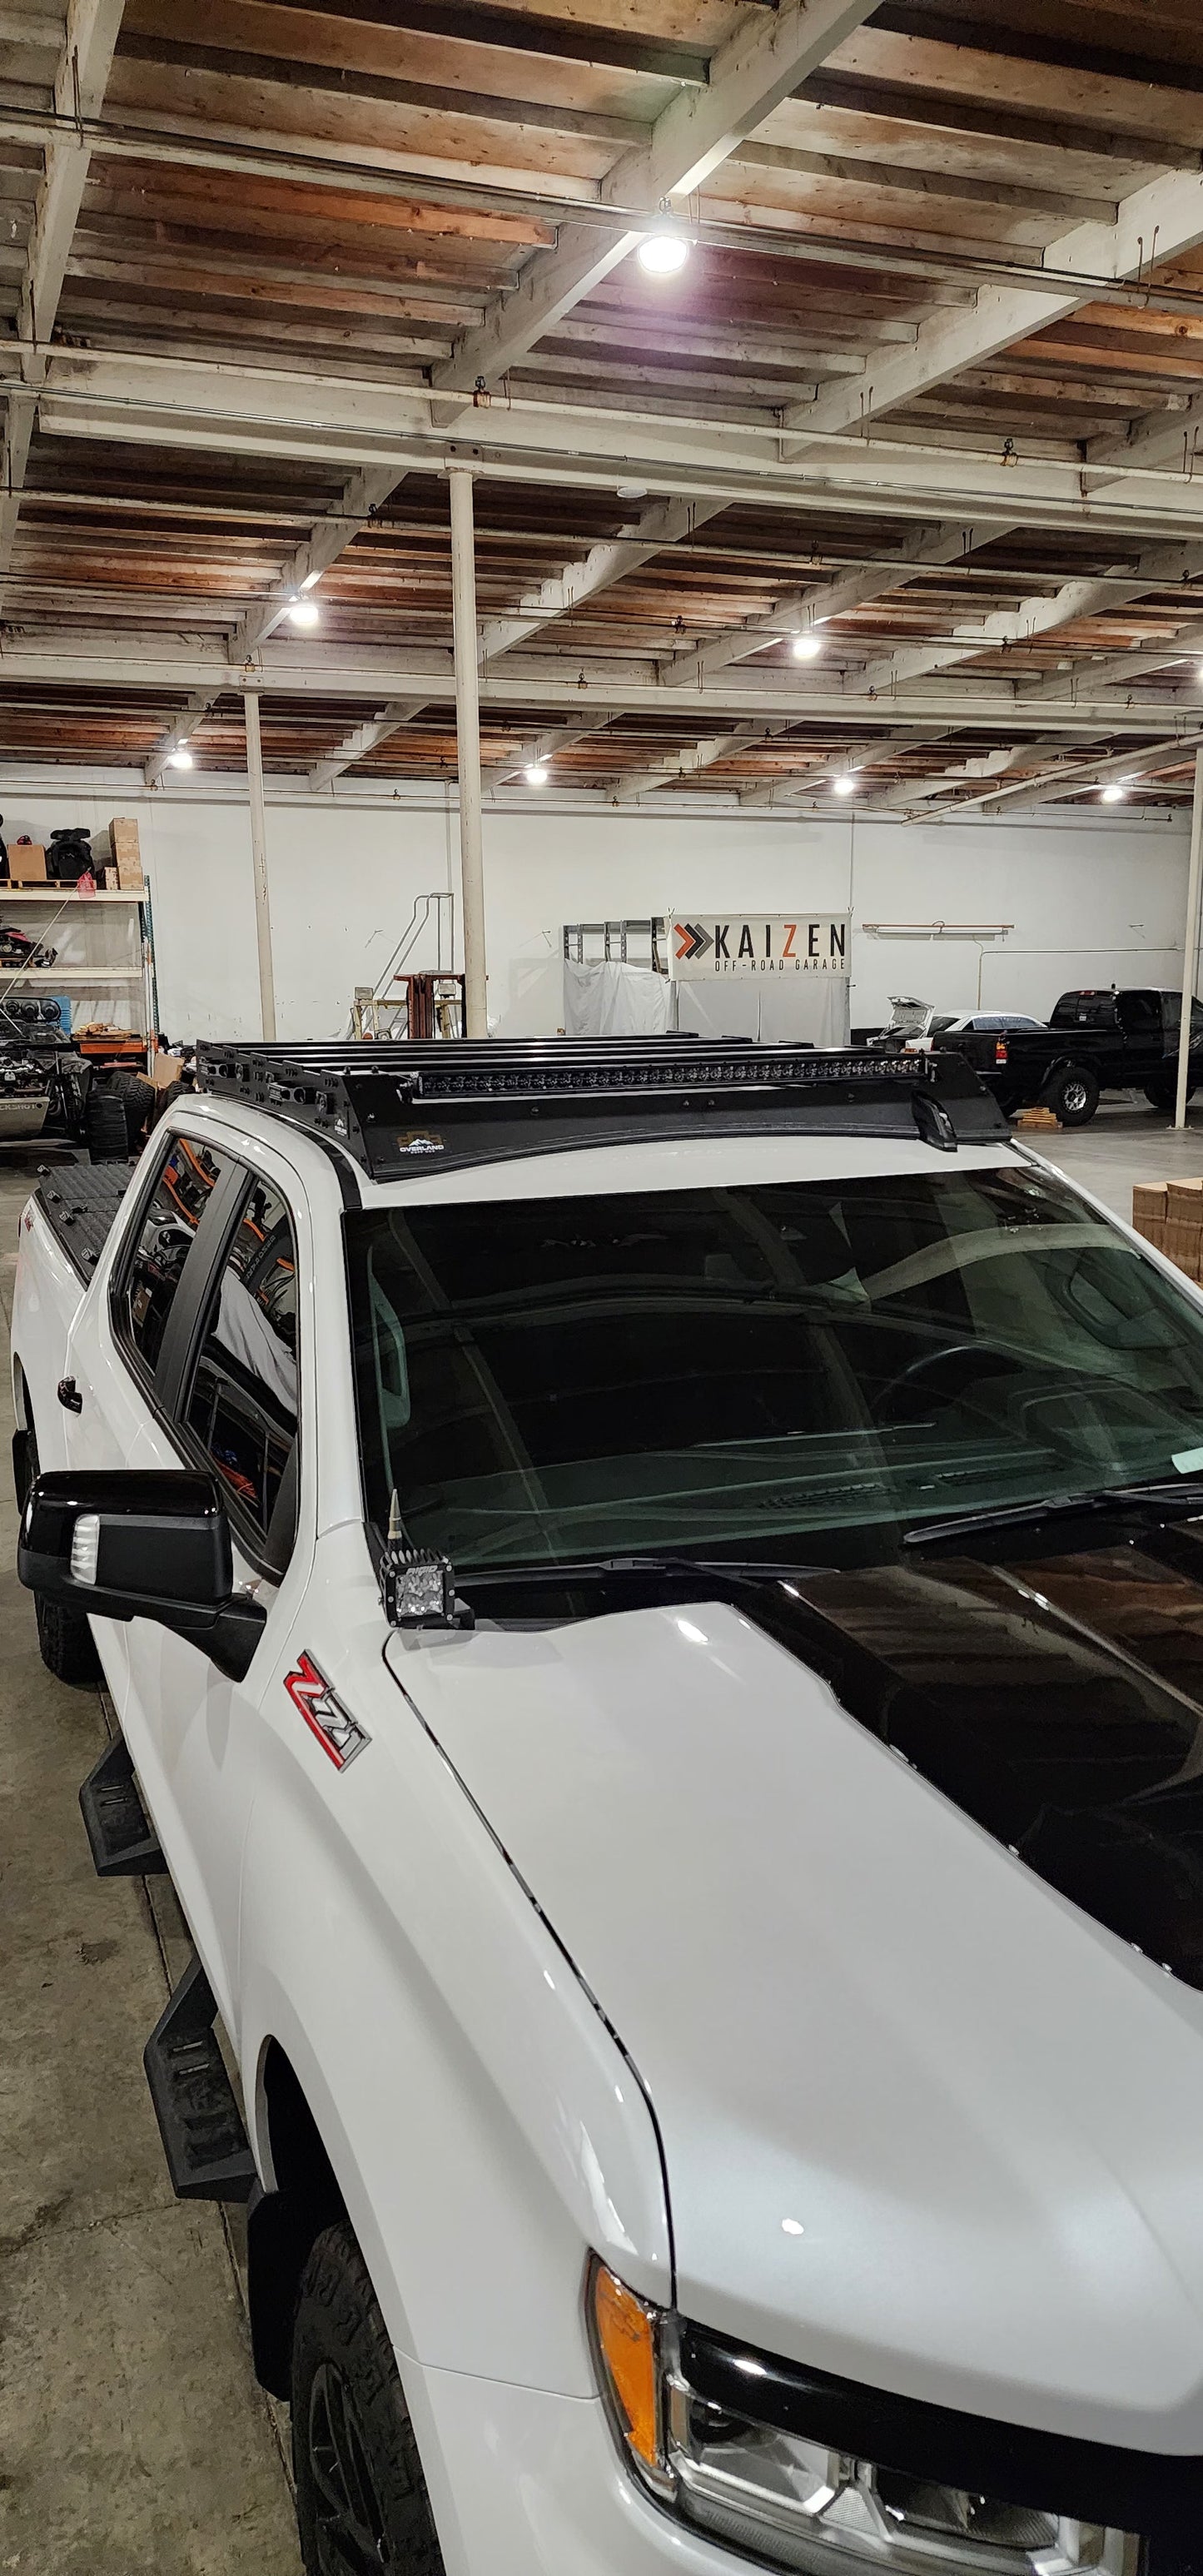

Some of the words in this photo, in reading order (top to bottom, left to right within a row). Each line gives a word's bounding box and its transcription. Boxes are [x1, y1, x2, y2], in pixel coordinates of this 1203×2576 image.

[714, 924, 846, 959] KAIZEN
[714, 959, 785, 972] OFF-ROAD
[795, 958, 846, 971] GARAGE
[399, 1144, 445, 1153] OVERLAND
[282, 1649, 373, 1773] Z71
